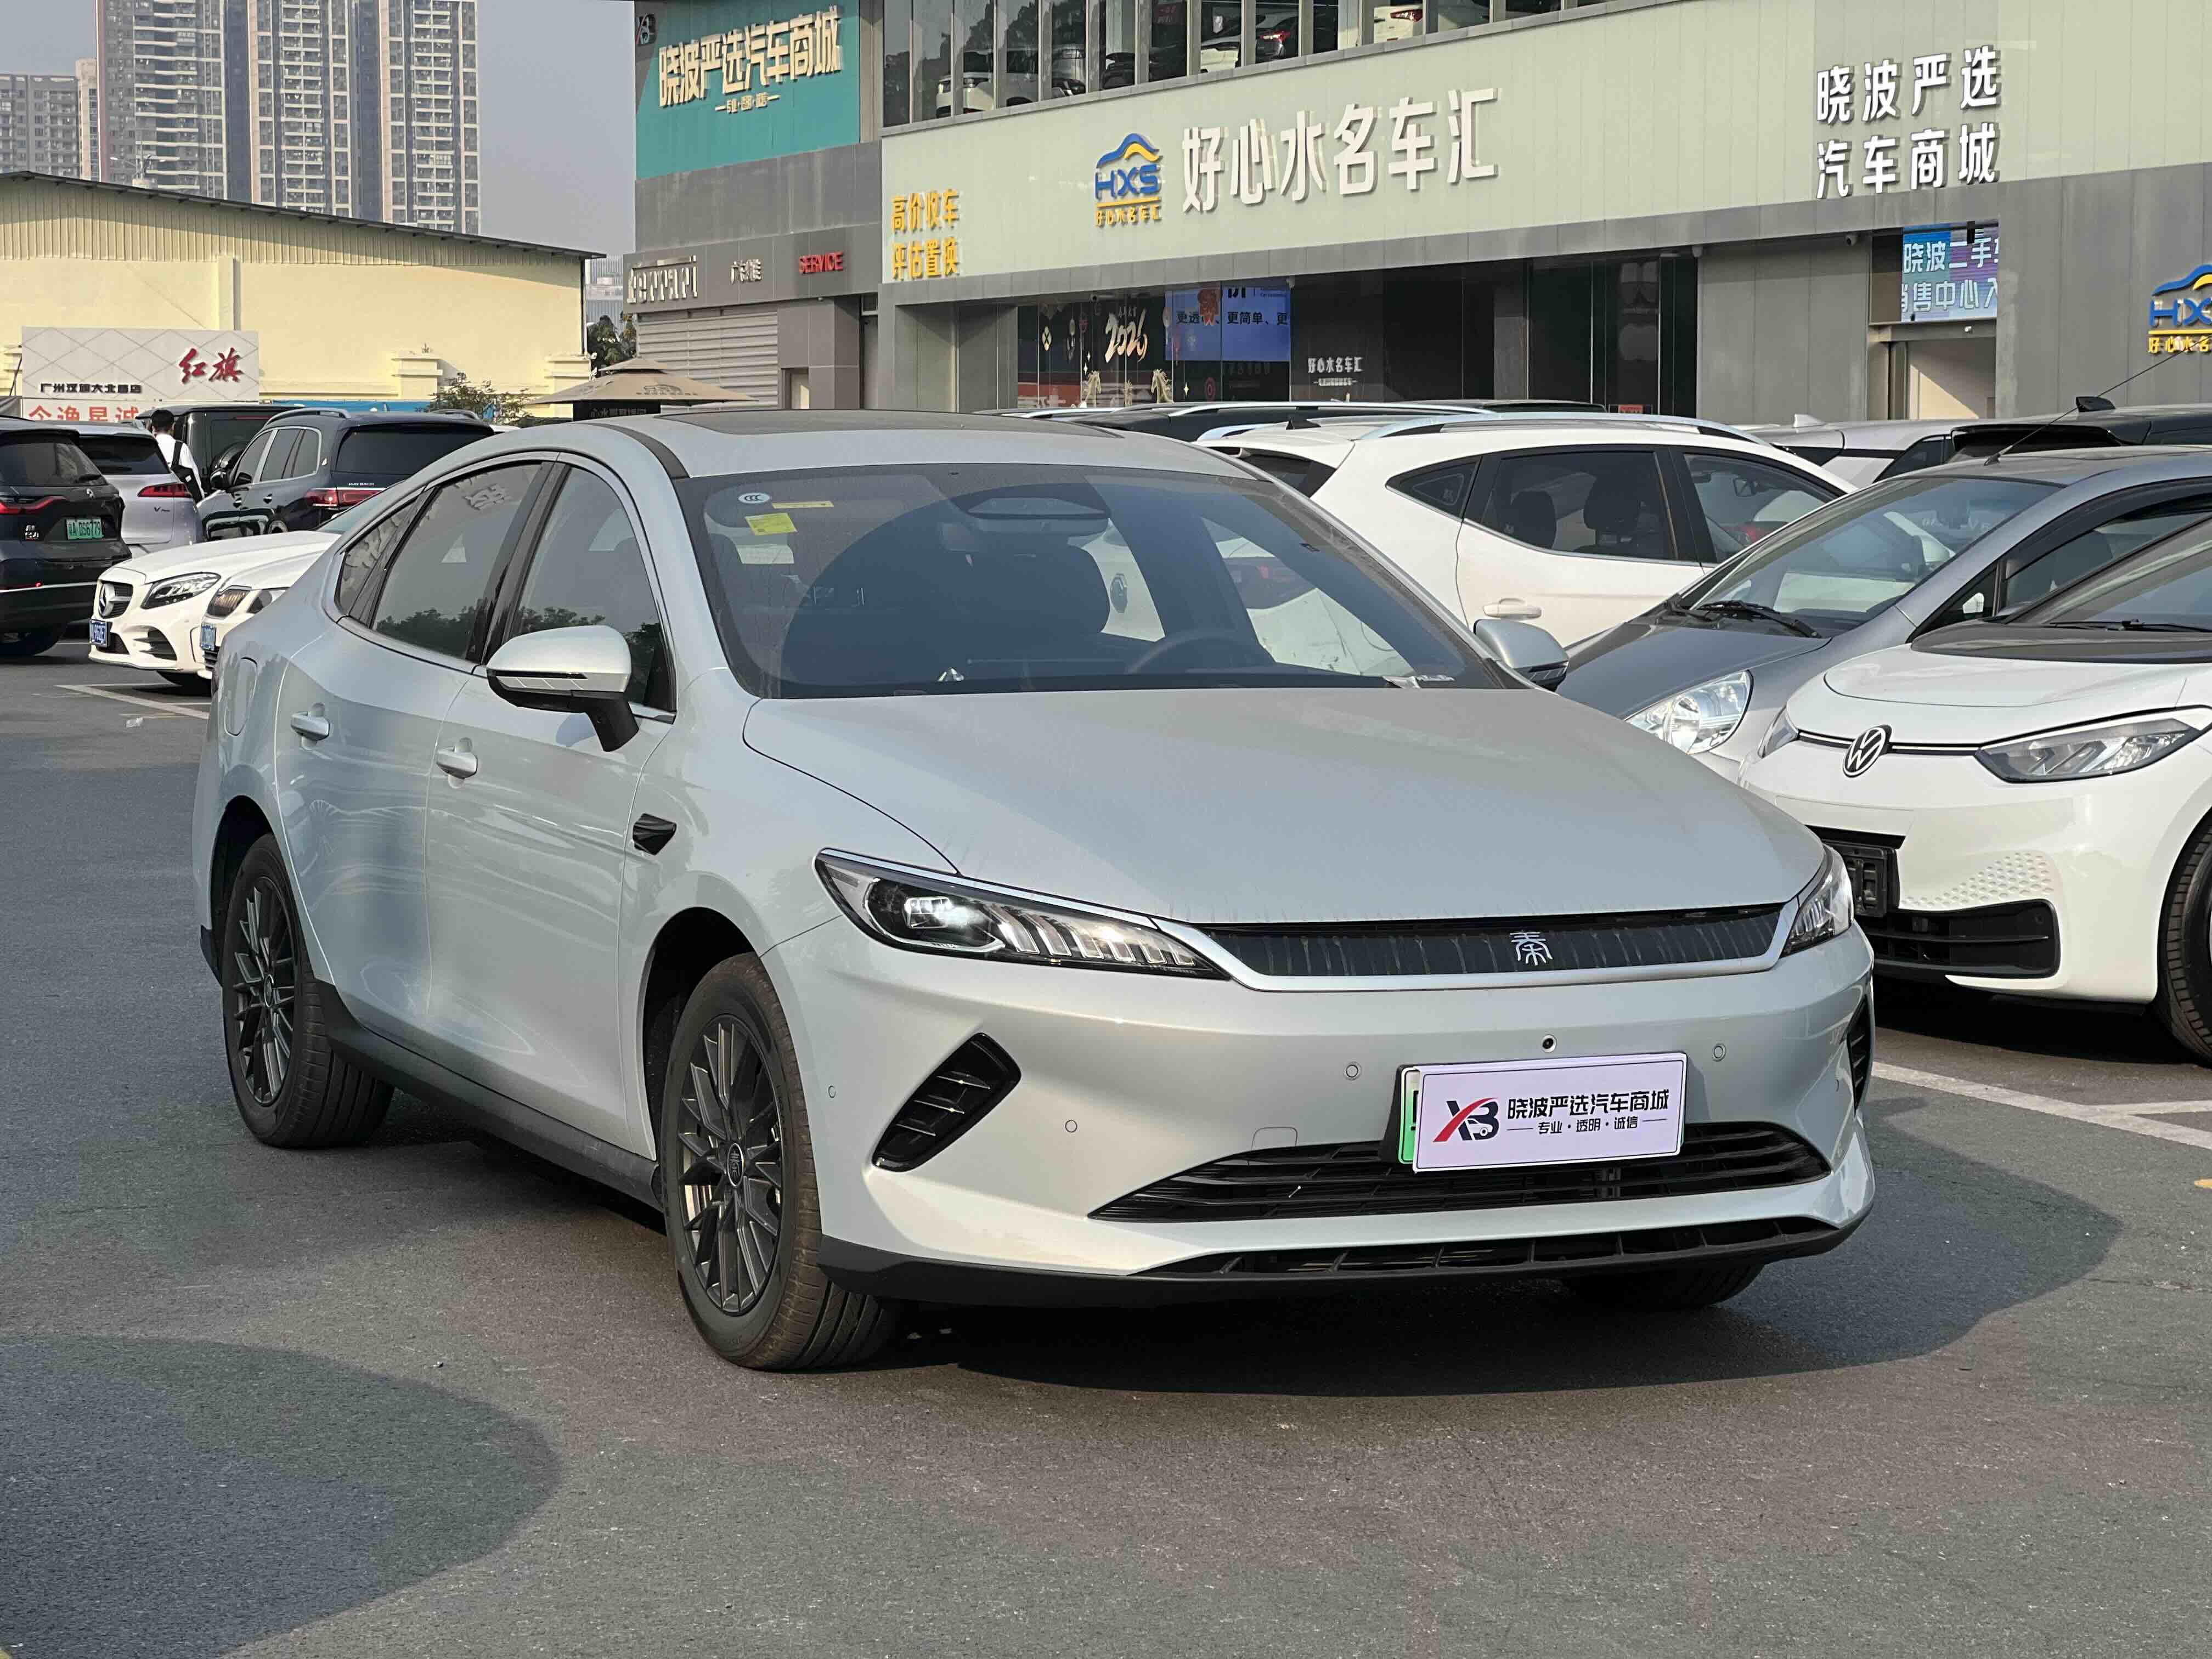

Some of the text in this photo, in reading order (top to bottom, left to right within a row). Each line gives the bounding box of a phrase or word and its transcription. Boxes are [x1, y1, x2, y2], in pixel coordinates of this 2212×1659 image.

[659, 5, 842, 106] 晓波严选汽车商城
[1816, 45, 2000, 125] 晓波严选
[1182, 88, 1499, 212] 好心水名车汇
[1816, 122, 2000, 199] 汽车商城
[1096, 164, 1160, 199] HXS
[891, 189, 957, 233] 高价收车
[798, 251, 843, 274] SERVICE
[891, 237, 958, 280] 评估置换
[1176, 312, 1288, 325] 更透、更简单、更
[178, 347, 244, 383] 红旗
[1308, 356, 1363, 373] 好心水名车汇
[1507, 1089, 1669, 1120] 晓波严选汽车商城
